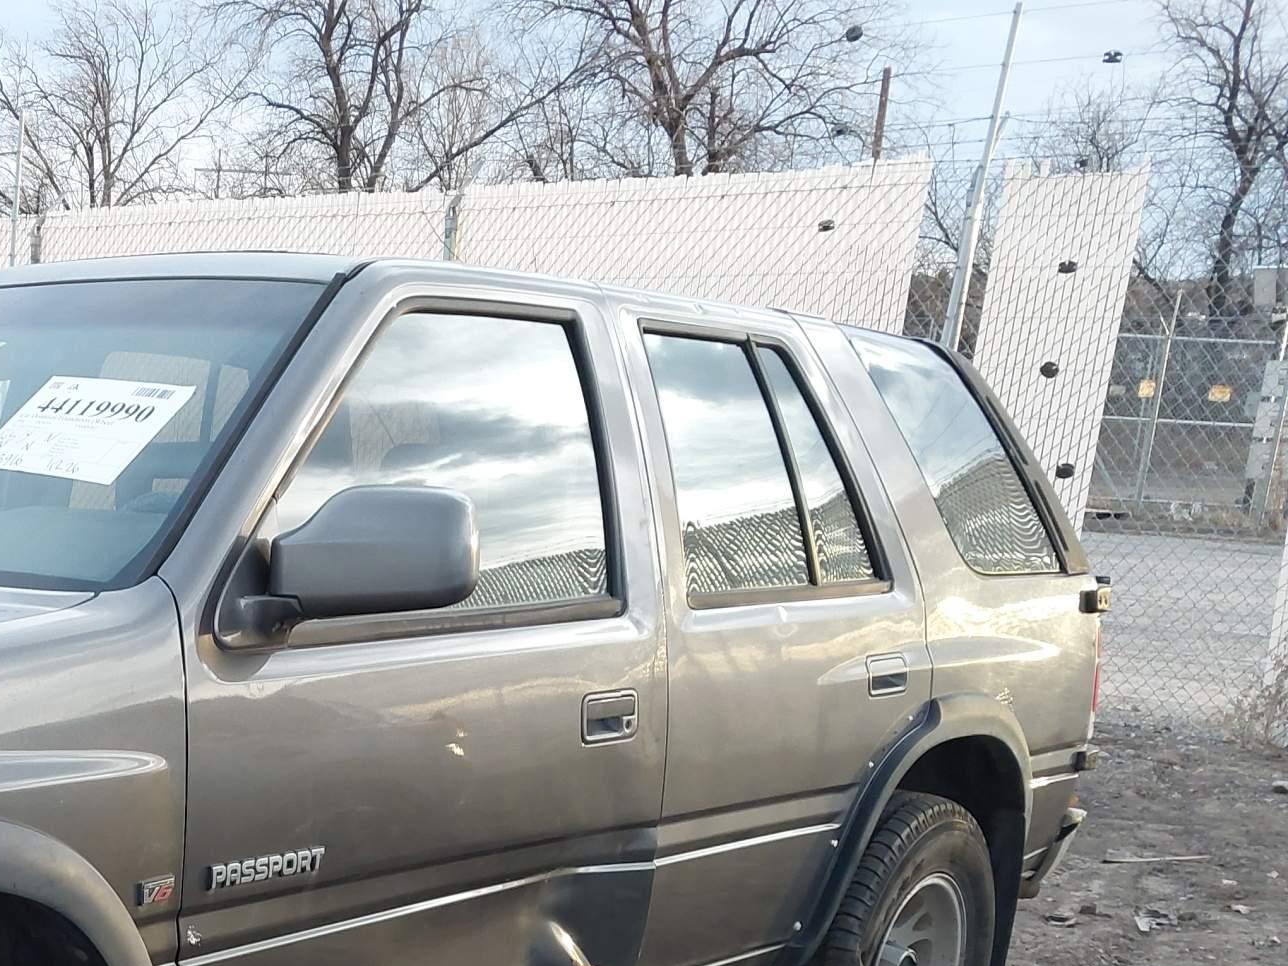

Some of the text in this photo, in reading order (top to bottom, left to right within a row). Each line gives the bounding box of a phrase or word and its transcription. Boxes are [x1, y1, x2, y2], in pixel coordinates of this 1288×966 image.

[37, 397, 156, 423] 44119990
[211, 847, 325, 890] PASSPORT
[144, 882, 173, 904] V6
